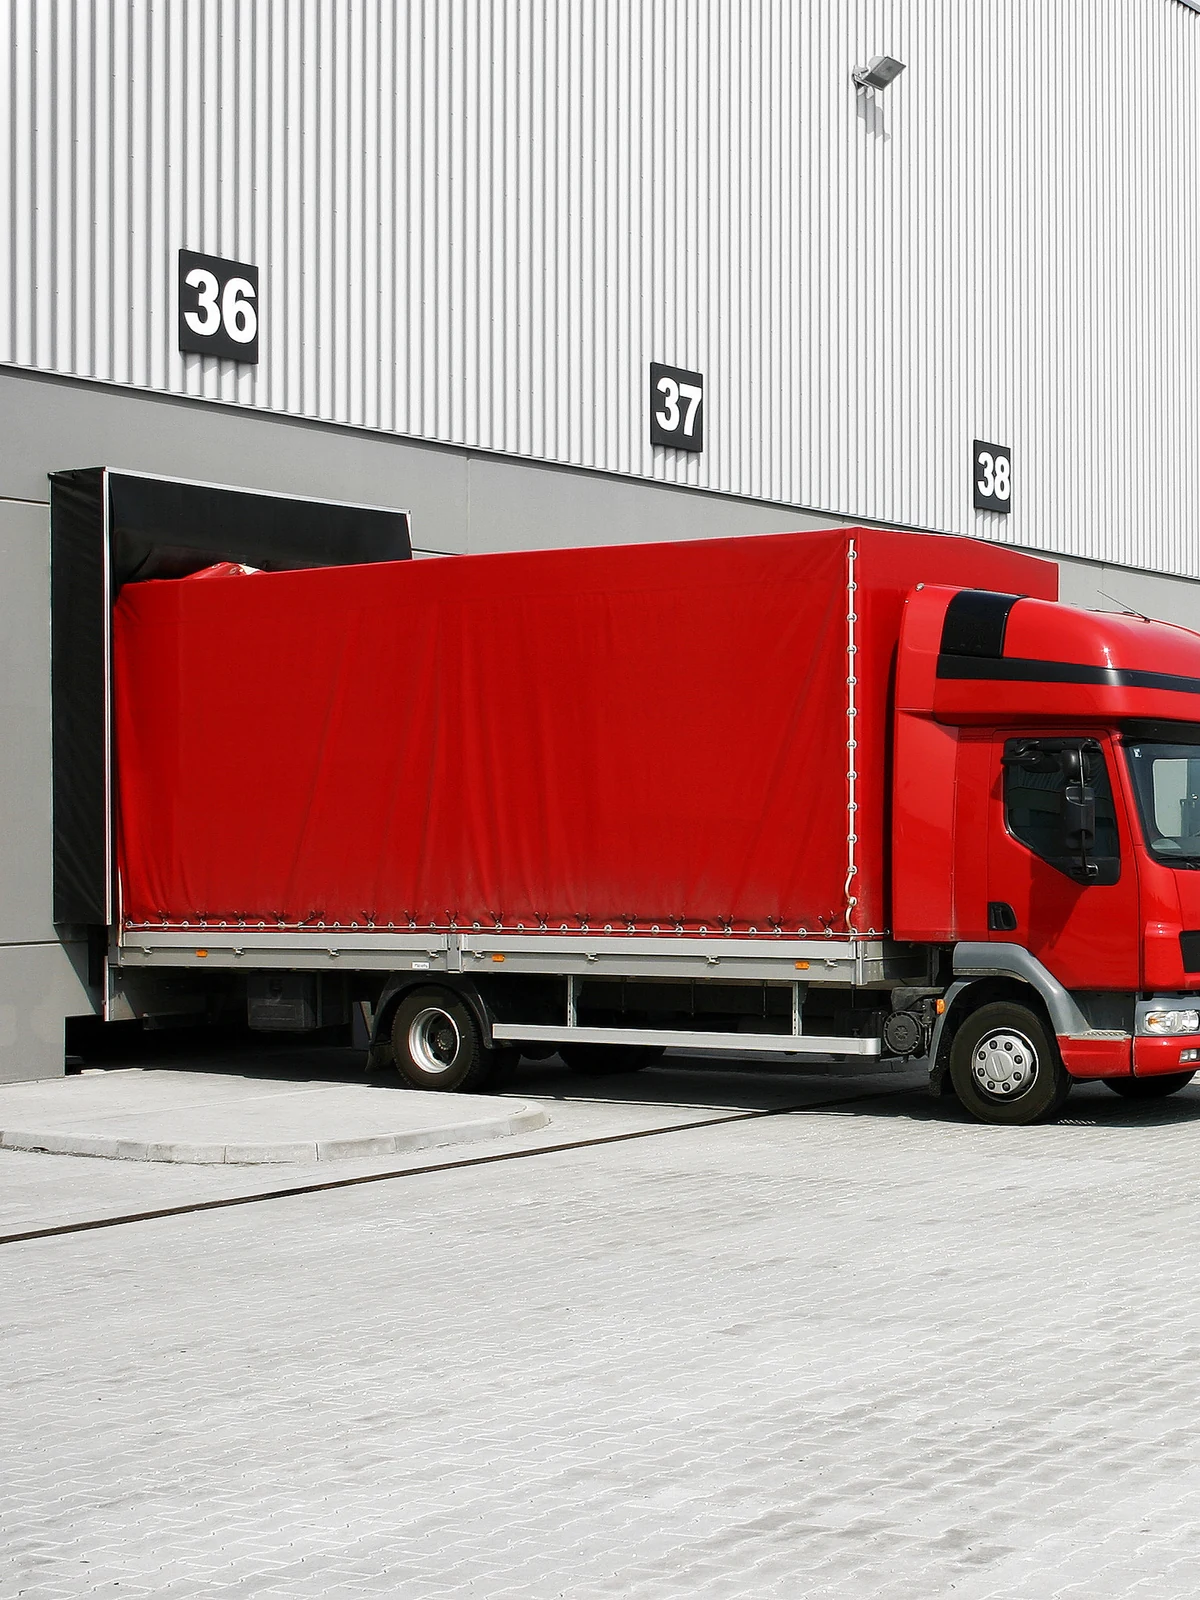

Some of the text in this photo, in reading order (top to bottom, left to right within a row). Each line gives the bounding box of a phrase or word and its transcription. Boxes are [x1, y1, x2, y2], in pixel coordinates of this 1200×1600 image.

[184, 268, 257, 344] 36
[655, 376, 702, 437] 37
[977, 451, 1011, 501] 38
